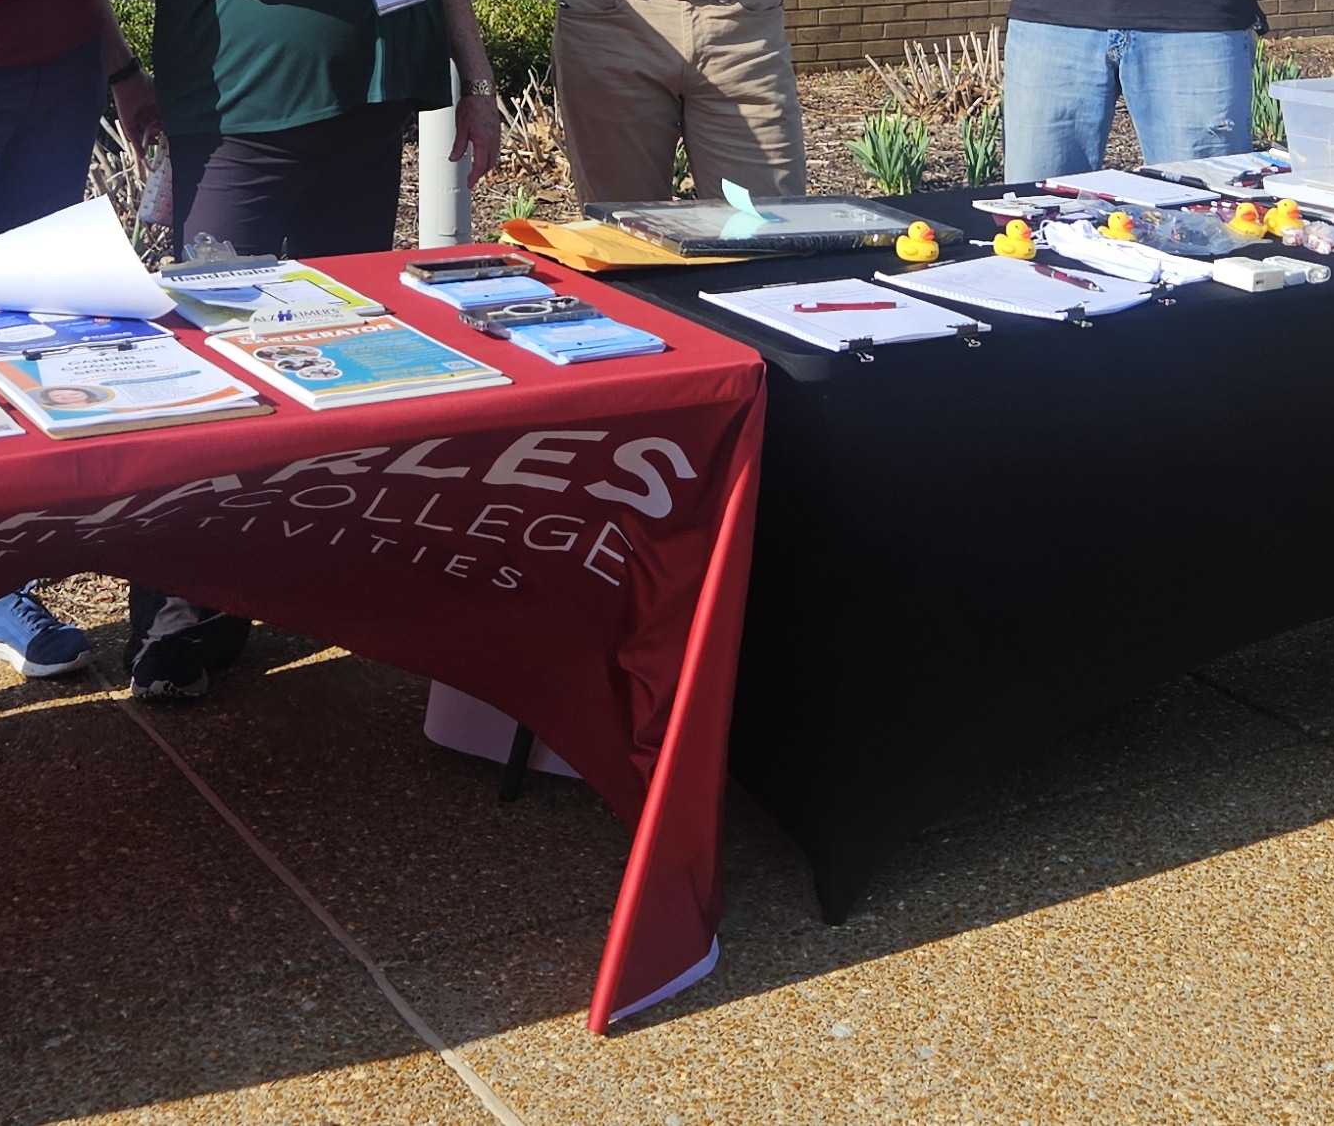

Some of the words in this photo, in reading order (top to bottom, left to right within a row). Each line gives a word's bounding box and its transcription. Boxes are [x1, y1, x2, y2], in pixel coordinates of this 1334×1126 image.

[61, 359, 155, 371] COACHING
[68, 356, 137, 365] CAREER
[74, 364, 157, 375] SERVICES
[219, 484, 634, 587] COLLEGE
